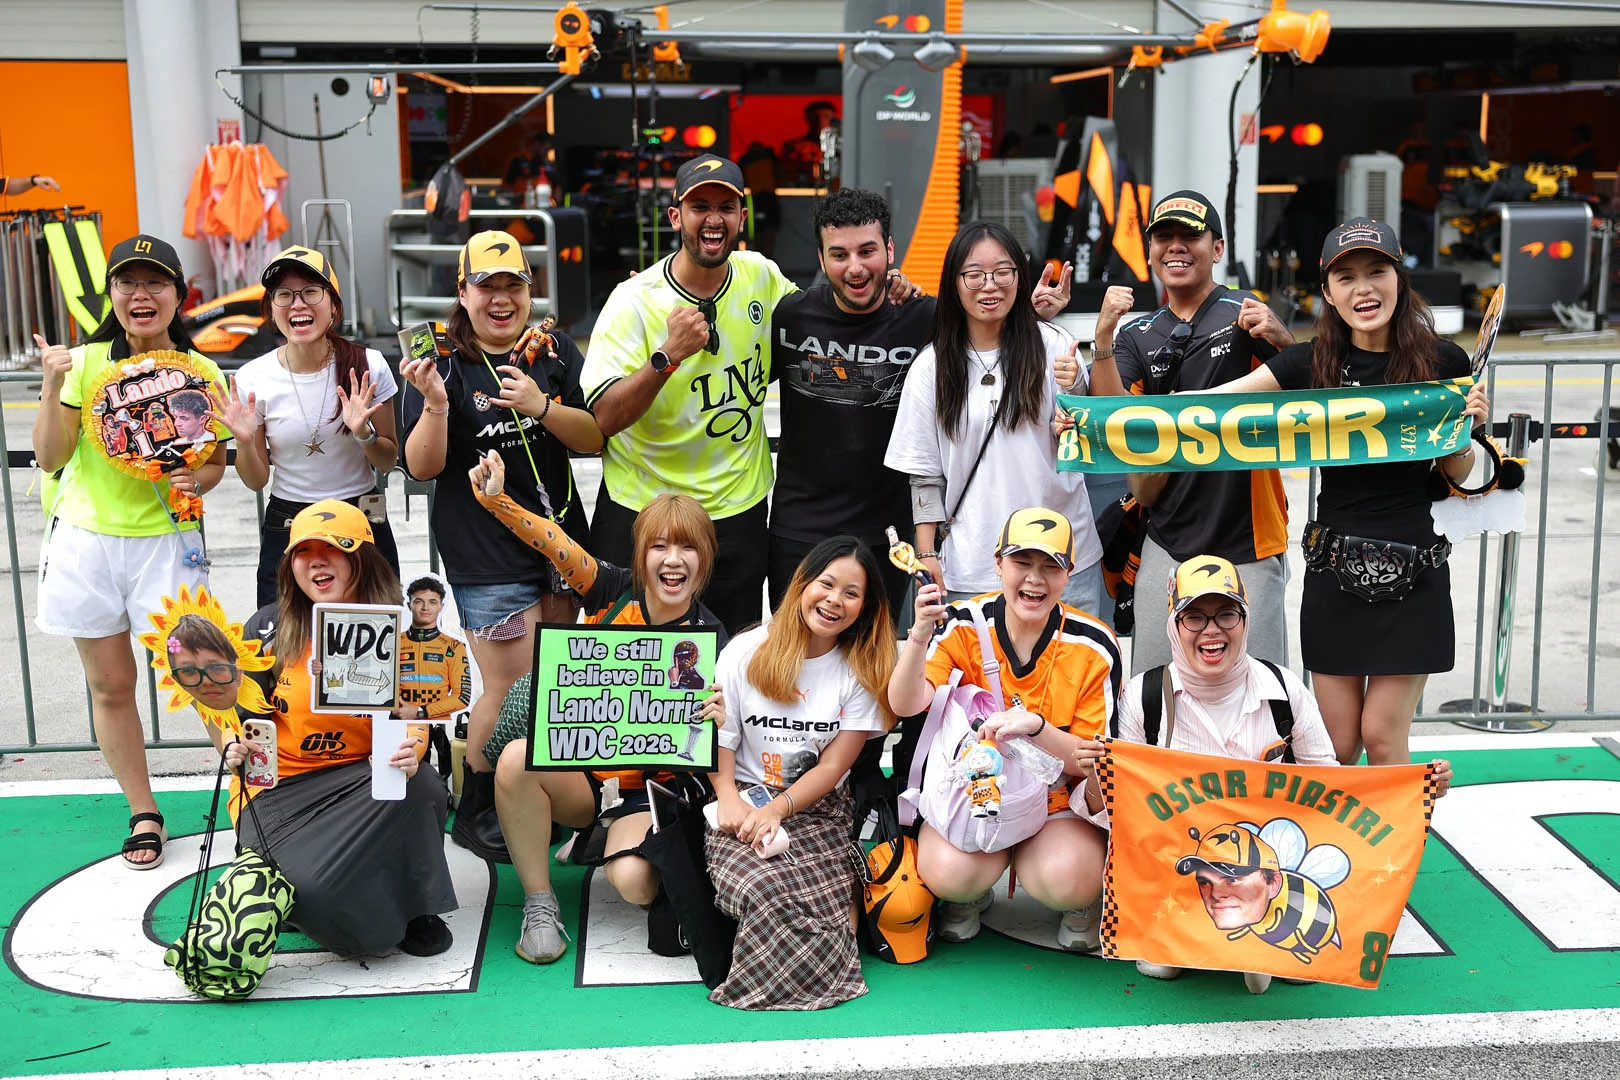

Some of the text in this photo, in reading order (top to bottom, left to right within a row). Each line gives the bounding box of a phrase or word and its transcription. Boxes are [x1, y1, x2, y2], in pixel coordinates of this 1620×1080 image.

[1157, 201, 1203, 214] PIRELLI
[779, 328, 918, 365] LANDO
[105, 368, 186, 409] Lando
[133, 430, 155, 460] 1
[501, 434, 537, 449] FORMLA
[1105, 397, 1388, 466] OSCAR
[326, 622, 394, 661] WDC
[568, 637, 662, 661] We still
[557, 664, 664, 687] believe in
[548, 689, 704, 724] Lando Norris
[744, 715, 840, 732] McLaren
[763, 735, 806, 743] FORMULA
[301, 732, 347, 752] ON
[548, 726, 678, 762] WDC 2026.
[1146, 769, 1395, 847] OSCAR PIASTRI
[1359, 931, 1394, 981] 8
